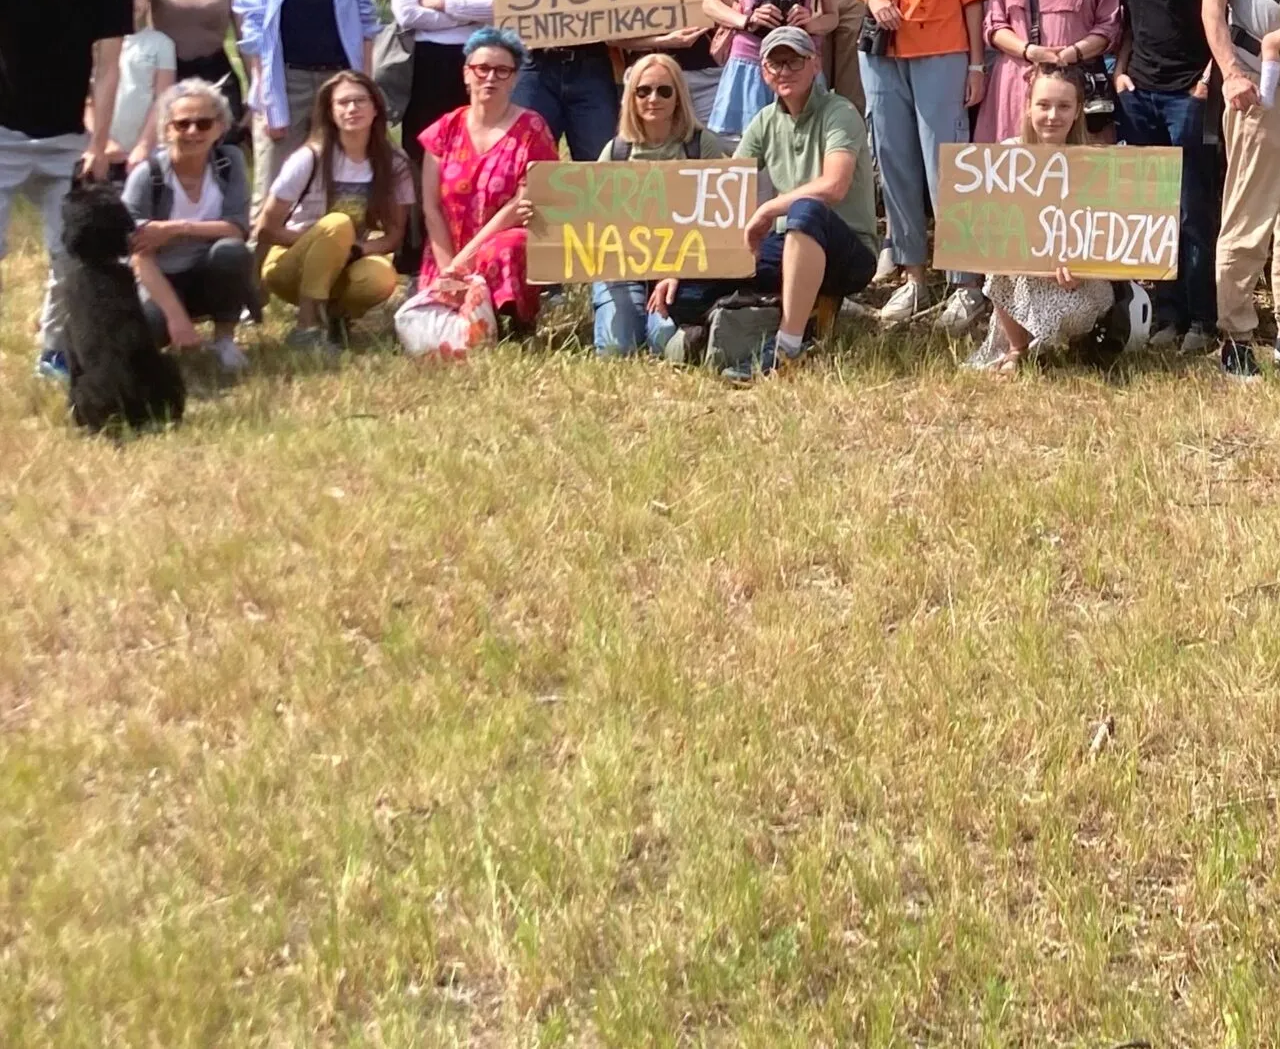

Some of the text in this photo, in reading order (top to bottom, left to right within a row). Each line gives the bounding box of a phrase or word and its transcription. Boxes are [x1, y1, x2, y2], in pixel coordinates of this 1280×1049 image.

[546, 164, 758, 229] SKRA JEST
[953, 145, 1069, 200] SKRA
[563, 221, 708, 279] NASZA
